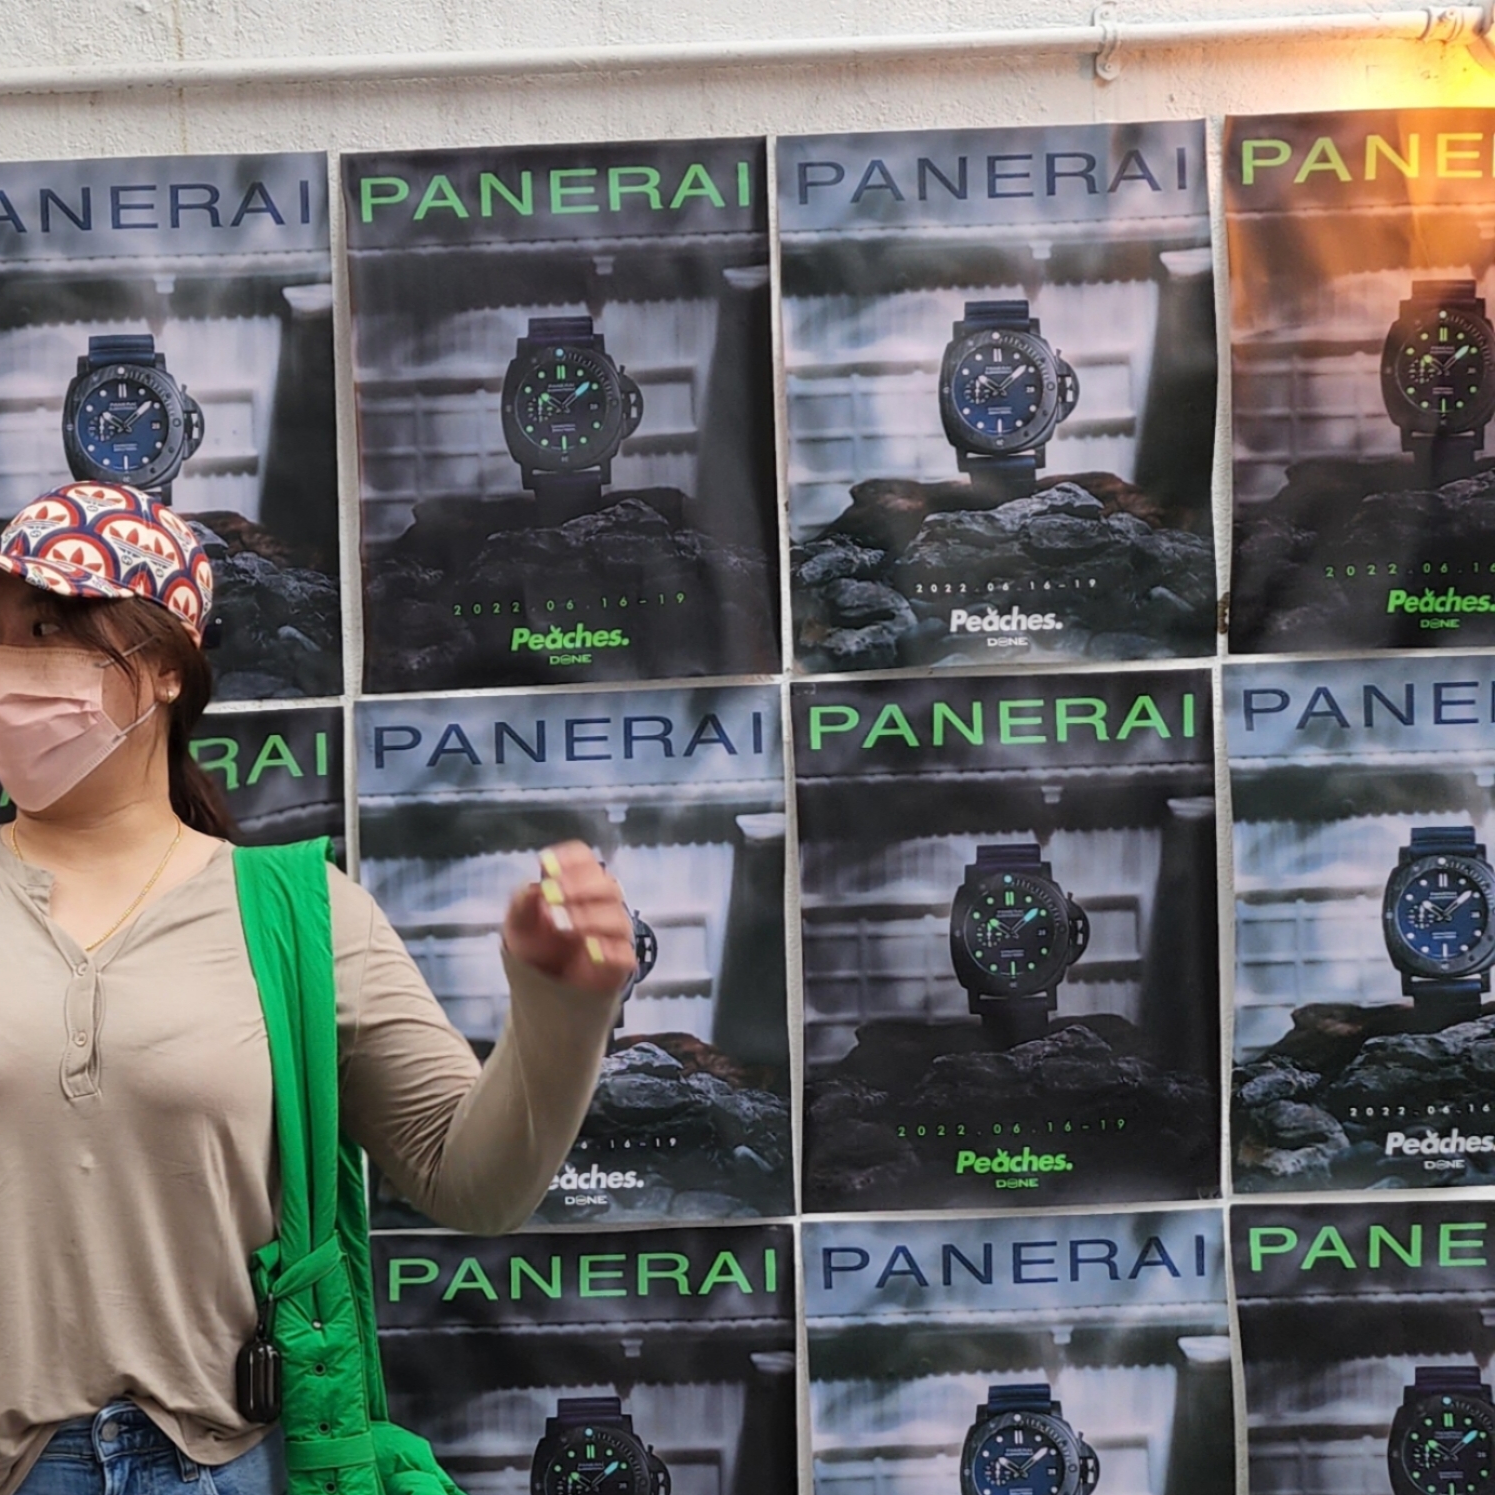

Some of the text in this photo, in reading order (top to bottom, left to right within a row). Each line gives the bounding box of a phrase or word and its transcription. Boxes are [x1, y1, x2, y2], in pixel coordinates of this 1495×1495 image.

[796, 147, 1188, 205] PANERAI
[1241, 132, 1495, 184] PANE
[359, 161, 751, 224] PANERAI
[808, 693, 1196, 751] PANERAI
[1243, 681, 1495, 732] PANE
[374, 710, 763, 769] PANERAI
[388, 1248, 777, 1303] PANERAI
[822, 1234, 1204, 1289] PANERAI
